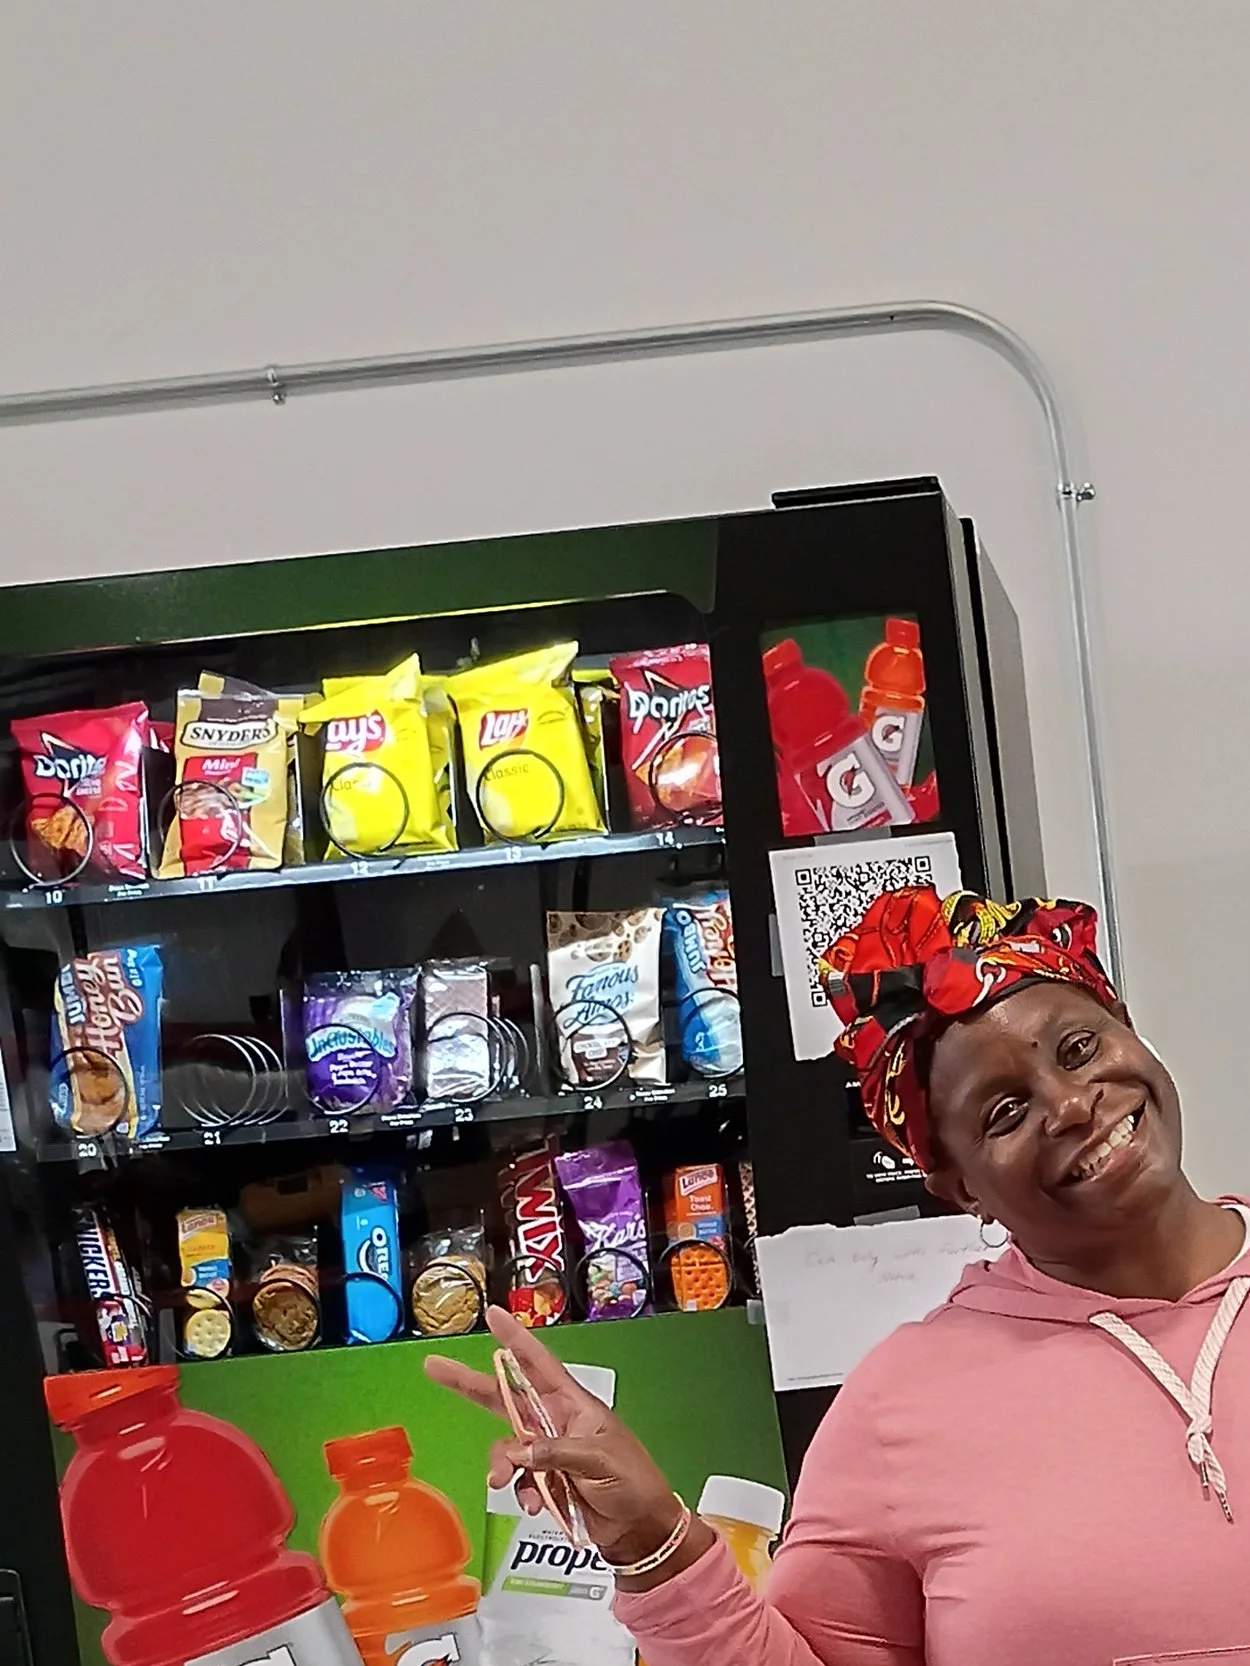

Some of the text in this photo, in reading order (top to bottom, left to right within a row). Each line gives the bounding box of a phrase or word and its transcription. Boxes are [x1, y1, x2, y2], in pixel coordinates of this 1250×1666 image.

[656, 832, 673, 846] 14
[505, 847, 522, 860] 13
[351, 862, 369, 875] 12
[45, 891, 63, 904] 10
[565, 964, 640, 1000] Famous
[709, 1085, 728, 1097] 25
[584, 1096, 602, 1109] 24
[455, 1108, 474, 1122] 23
[329, 1120, 348, 1133] 22
[204, 1131, 222, 1145] 21
[78, 1143, 97, 1157] 20
